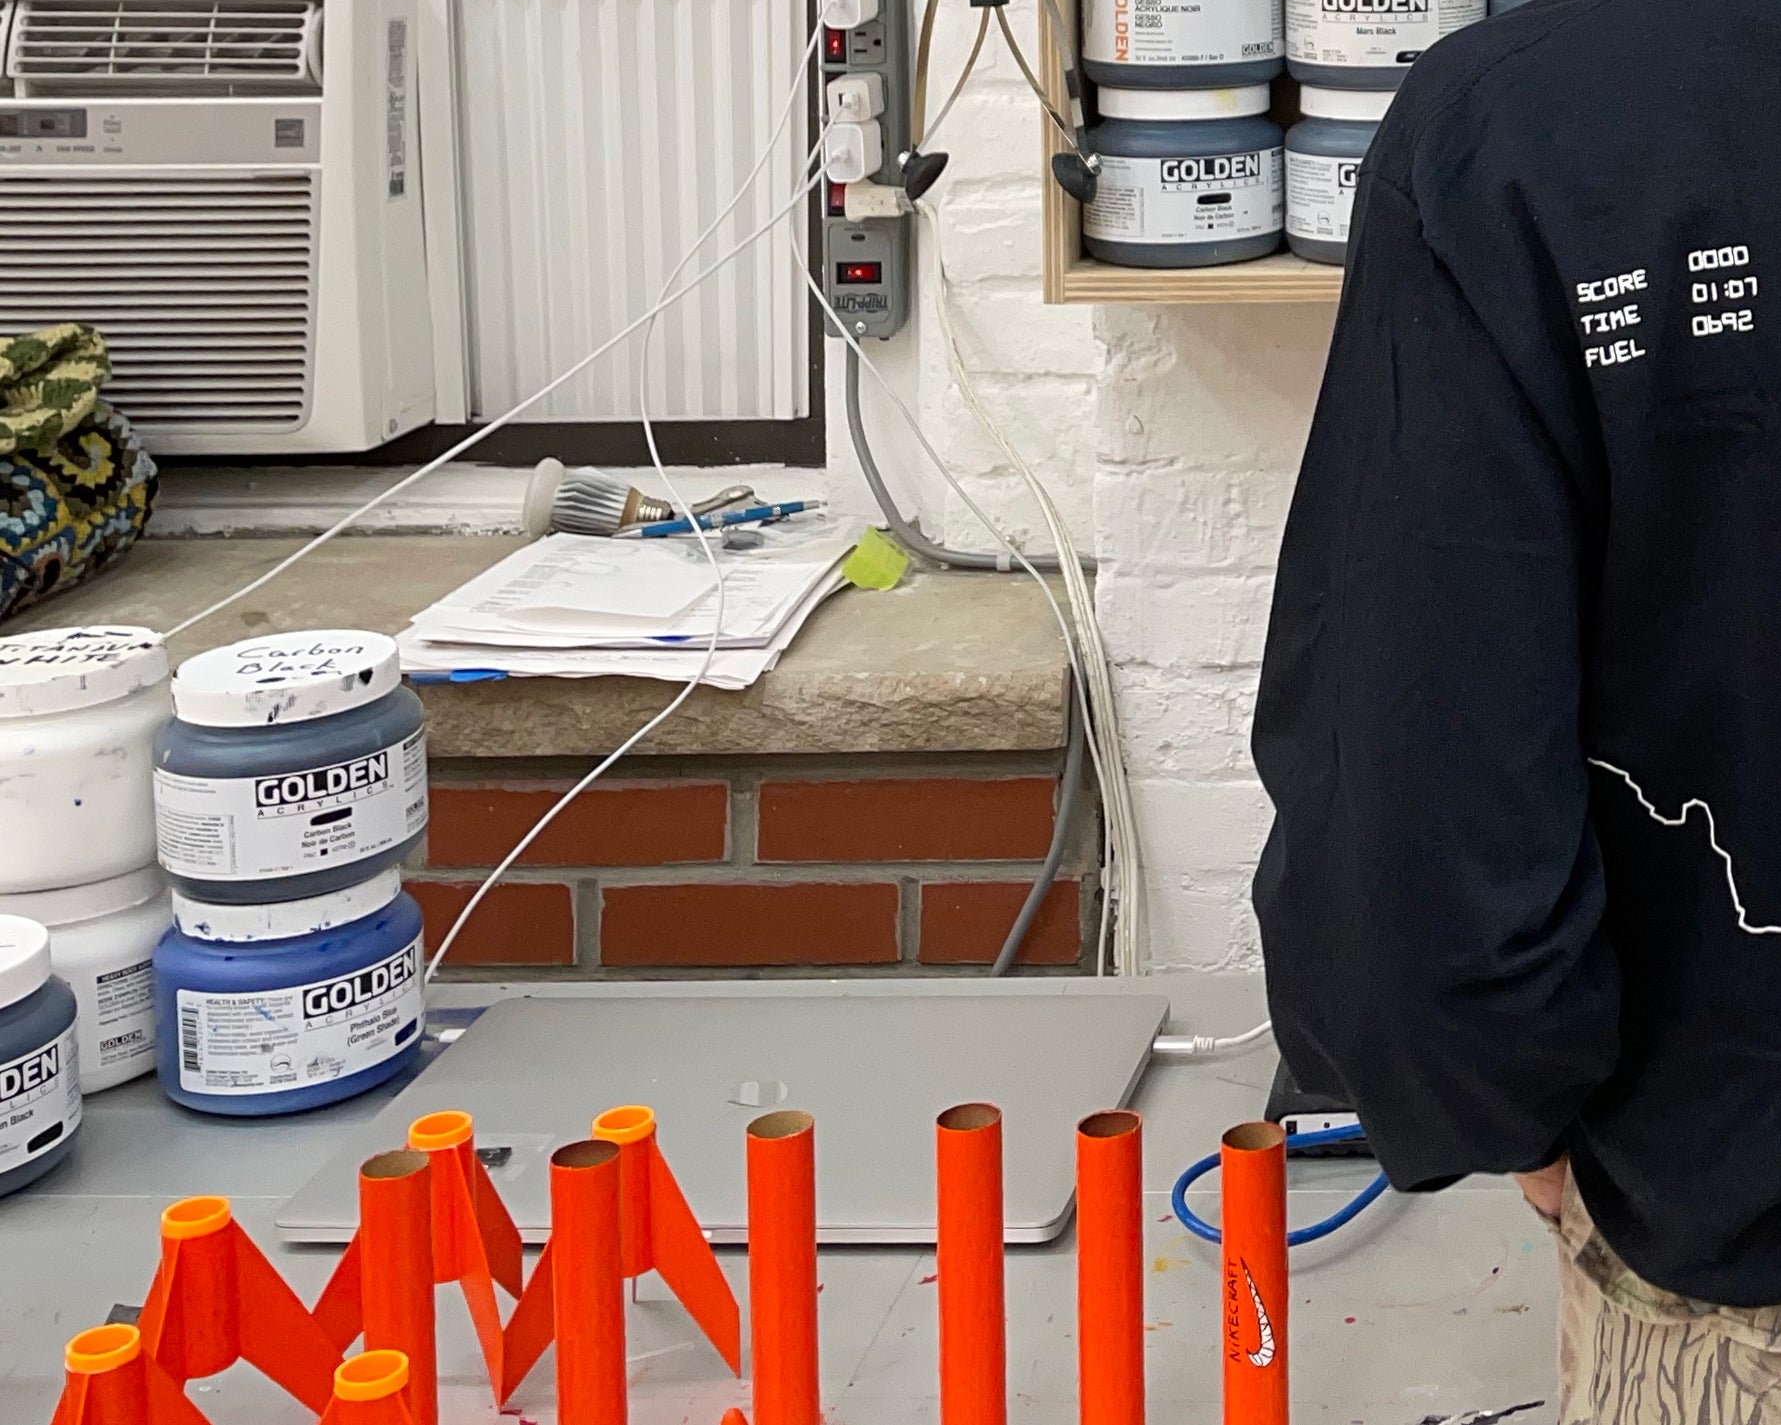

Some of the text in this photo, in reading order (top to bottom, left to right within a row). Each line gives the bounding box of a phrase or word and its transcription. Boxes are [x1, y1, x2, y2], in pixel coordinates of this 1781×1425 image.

[1356, 27, 1397, 35] Mars Black
[1162, 154, 1259, 182] GOLDEN
[1576, 245, 1750, 304] SCORE 0000
[1581, 277, 1759, 336] TIME 01:07
[1584, 339, 1647, 369] FUEL
[237, 643, 364, 658] Carbon
[236, 658, 336, 674] Black
[257, 754, 387, 806] GOLDEN
[304, 822, 352, 839] Carbon Black
[305, 948, 415, 1016] GOLDEN
[350, 1016, 381, 1032] Phthalo
[101, 1030, 142, 1049] GOLDEN
[347, 1029, 376, 1048] (Green
[0, 1047, 57, 1100] DEN
[10, 1110, 34, 1126] Black
[1227, 1260, 1242, 1363] NIKECRAFT
